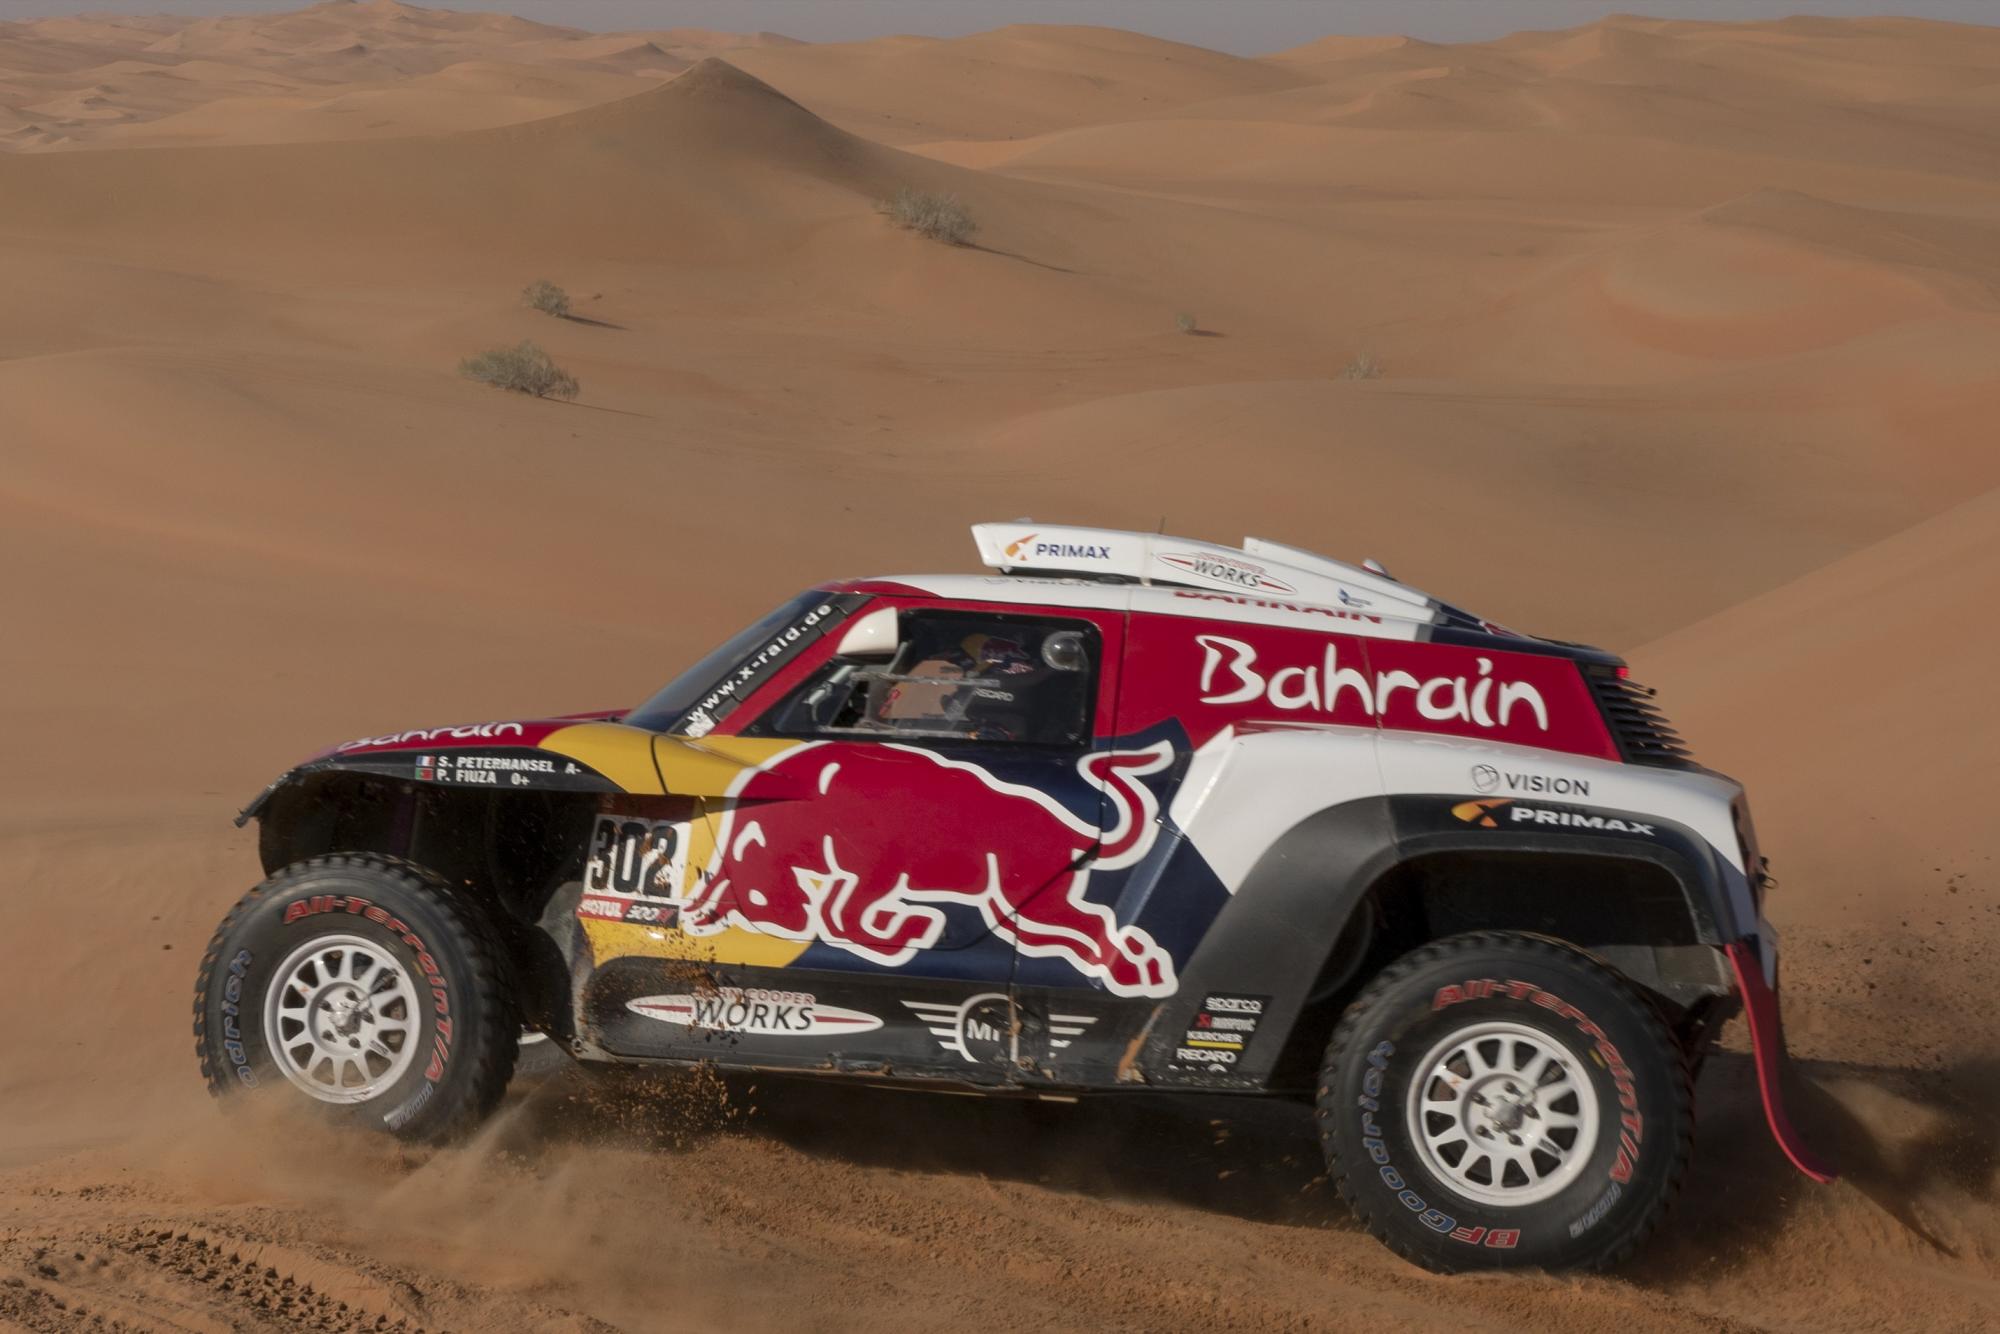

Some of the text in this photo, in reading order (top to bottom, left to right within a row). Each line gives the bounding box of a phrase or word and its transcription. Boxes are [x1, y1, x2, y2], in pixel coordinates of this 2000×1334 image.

[1036, 543, 1111, 560] PRIMAX
[1193, 559, 1261, 587] WORKS
[1195, 634, 1549, 732] Bahrain
[436, 769, 450, 781] P.
[455, 770, 497, 784] FIUZA
[437, 756, 454, 768] S.
[456, 756, 556, 773] PETERHANSEL
[1505, 773, 1590, 797] VISION
[1511, 806, 1656, 837] PRIMAX
[590, 819, 678, 899] 302
[744, 986, 817, 1006] COOPER
[695, 997, 814, 1031] WORKS
[1176, 1047, 1238, 1064] RECARO
